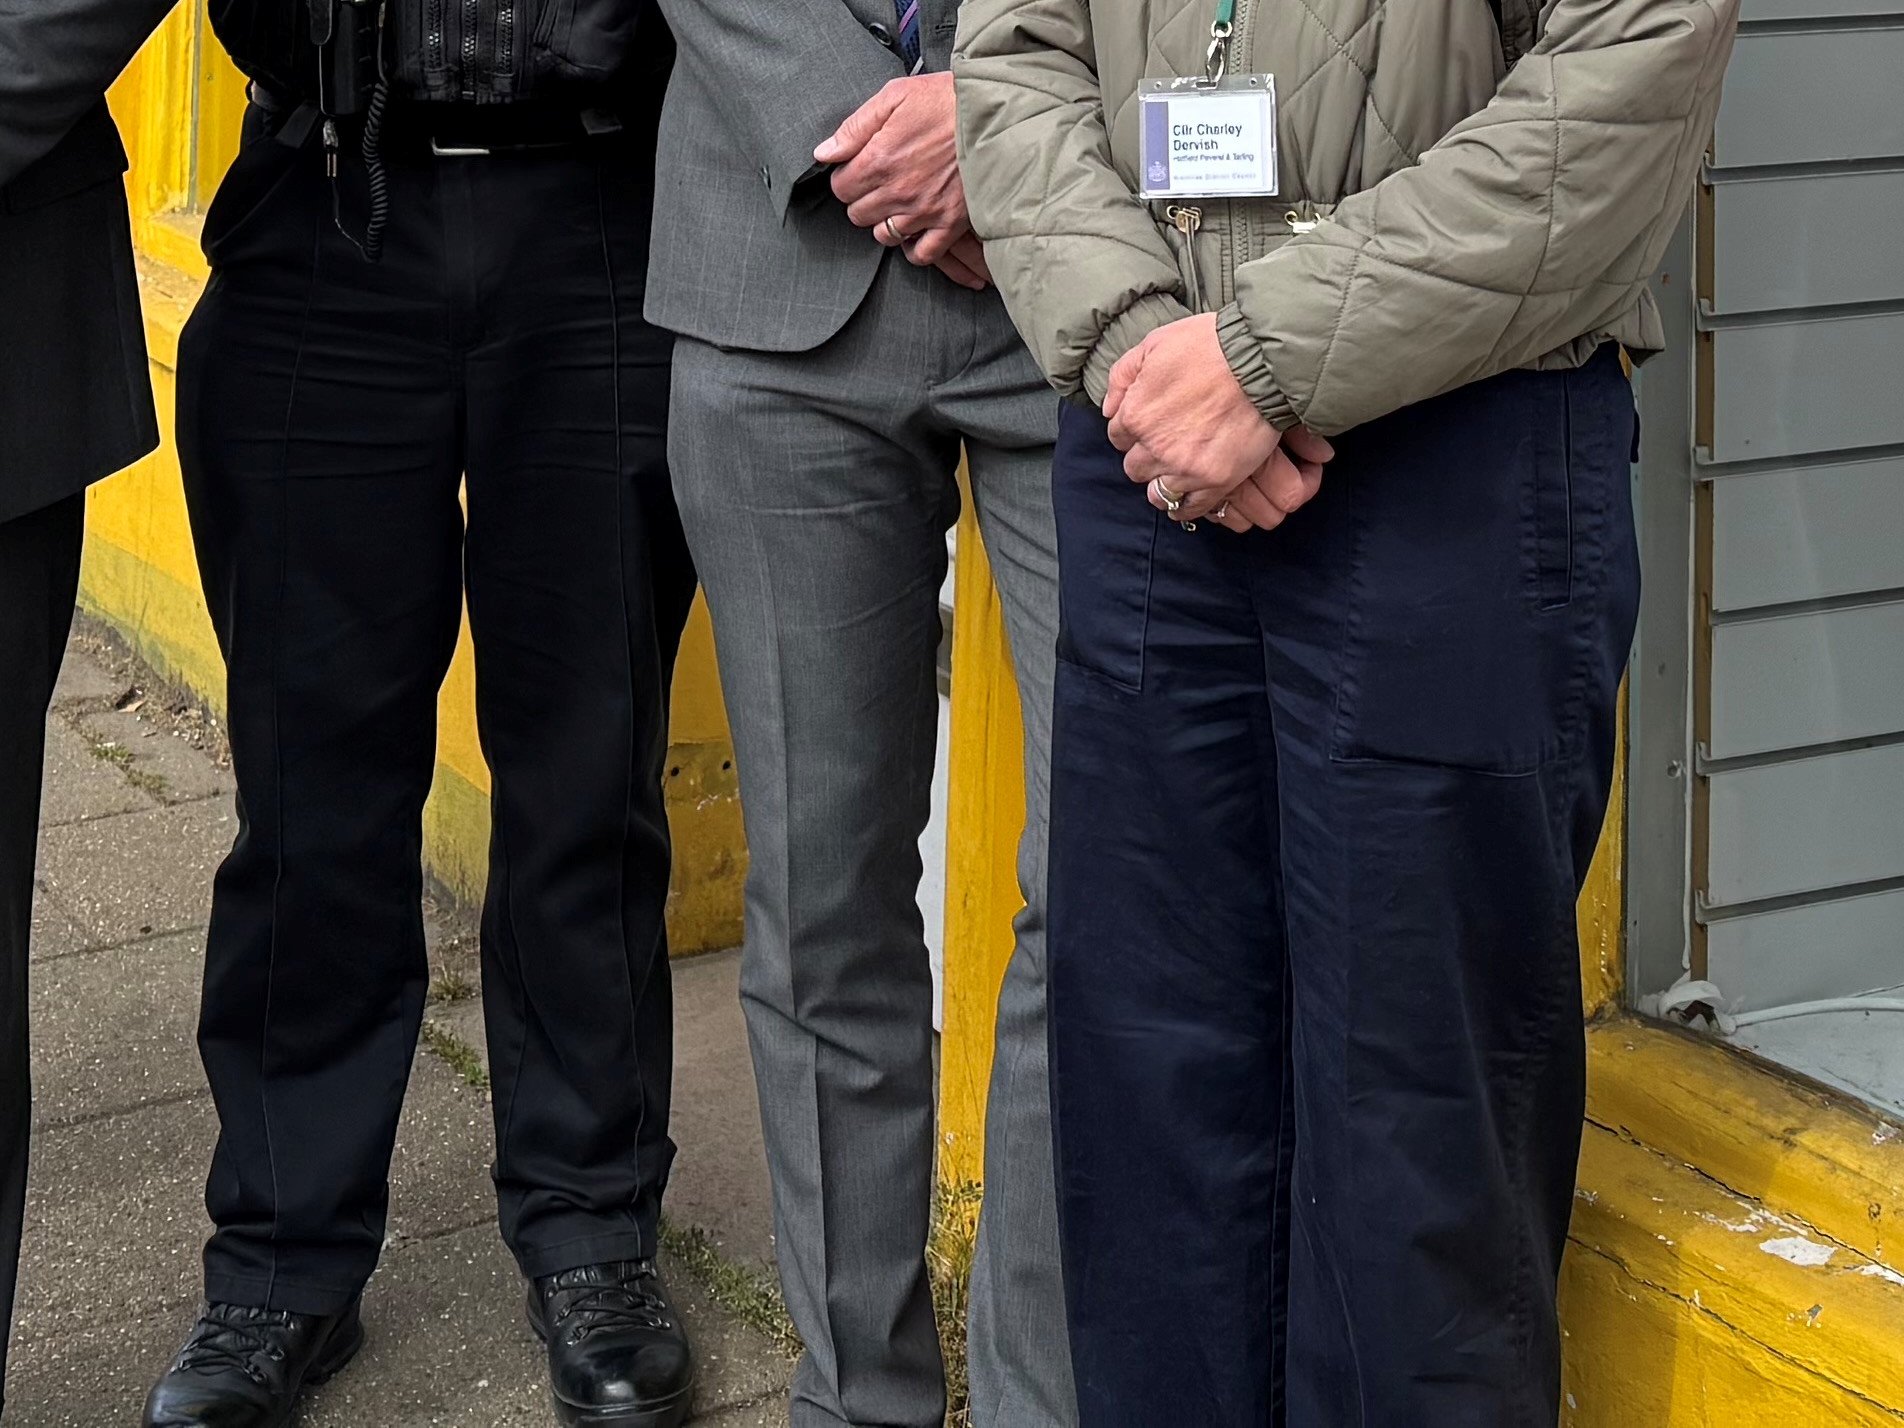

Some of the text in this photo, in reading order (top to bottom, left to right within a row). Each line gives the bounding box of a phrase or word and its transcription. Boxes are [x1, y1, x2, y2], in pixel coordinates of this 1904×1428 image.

[1173, 123, 1243, 138] Cllr Charley
[1173, 139, 1218, 151] Dervish
